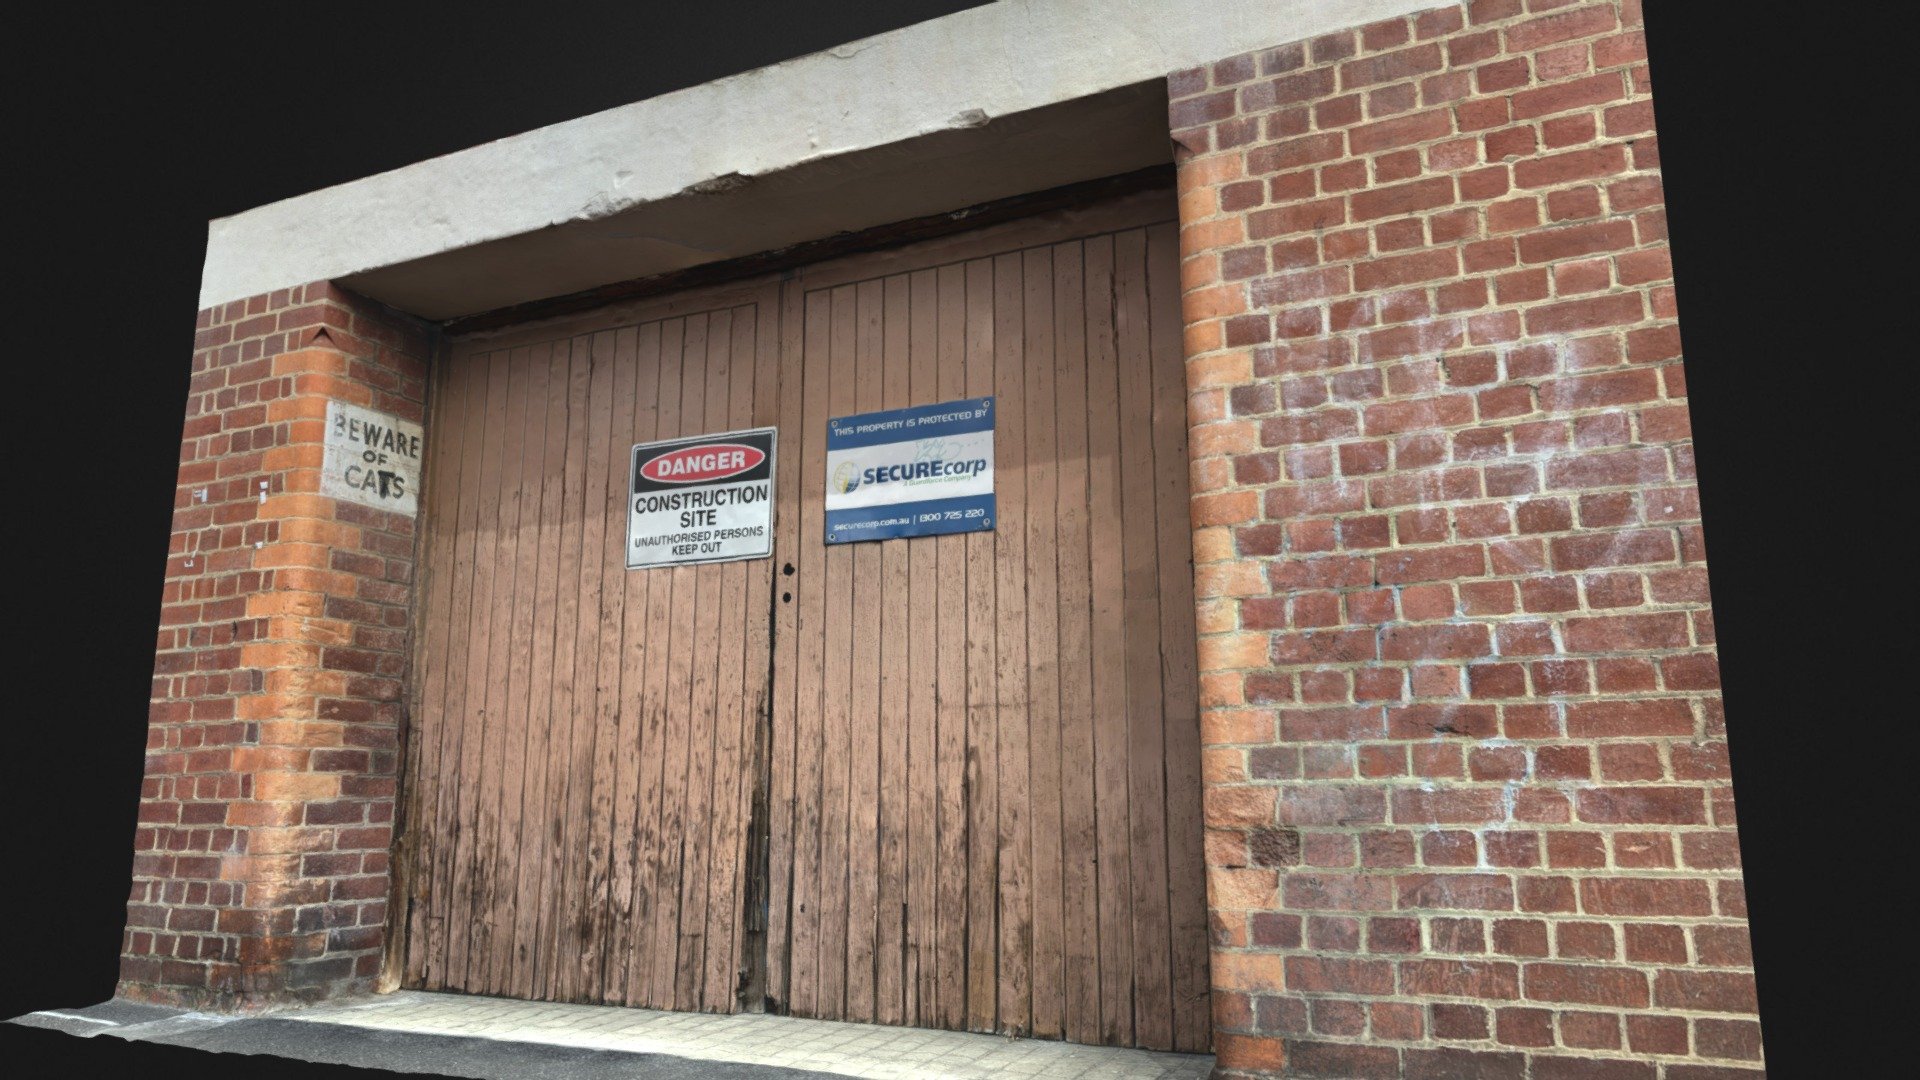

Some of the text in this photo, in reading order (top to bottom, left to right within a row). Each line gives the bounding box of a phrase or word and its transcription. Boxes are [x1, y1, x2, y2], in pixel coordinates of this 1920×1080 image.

[834, 408, 988, 437] THIS PROPERTY IS PROTECTED BY
[334, 413, 421, 460] BEWARE
[362, 450, 389, 466] OF
[657, 450, 746, 477] DANGER
[344, 465, 405, 500] CATS
[863, 458, 987, 485] SECUREcorp
[944, 474, 972, 485] Company
[635, 484, 768, 514] CONSTRUCTION
[680, 509, 717, 528] SITE
[833, 508, 985, 531] securecorp.com.au 1300 725 220
[634, 525, 764, 548] UNAUTHORISED PERSONS
[671, 541, 723, 556] KEEP OUT
